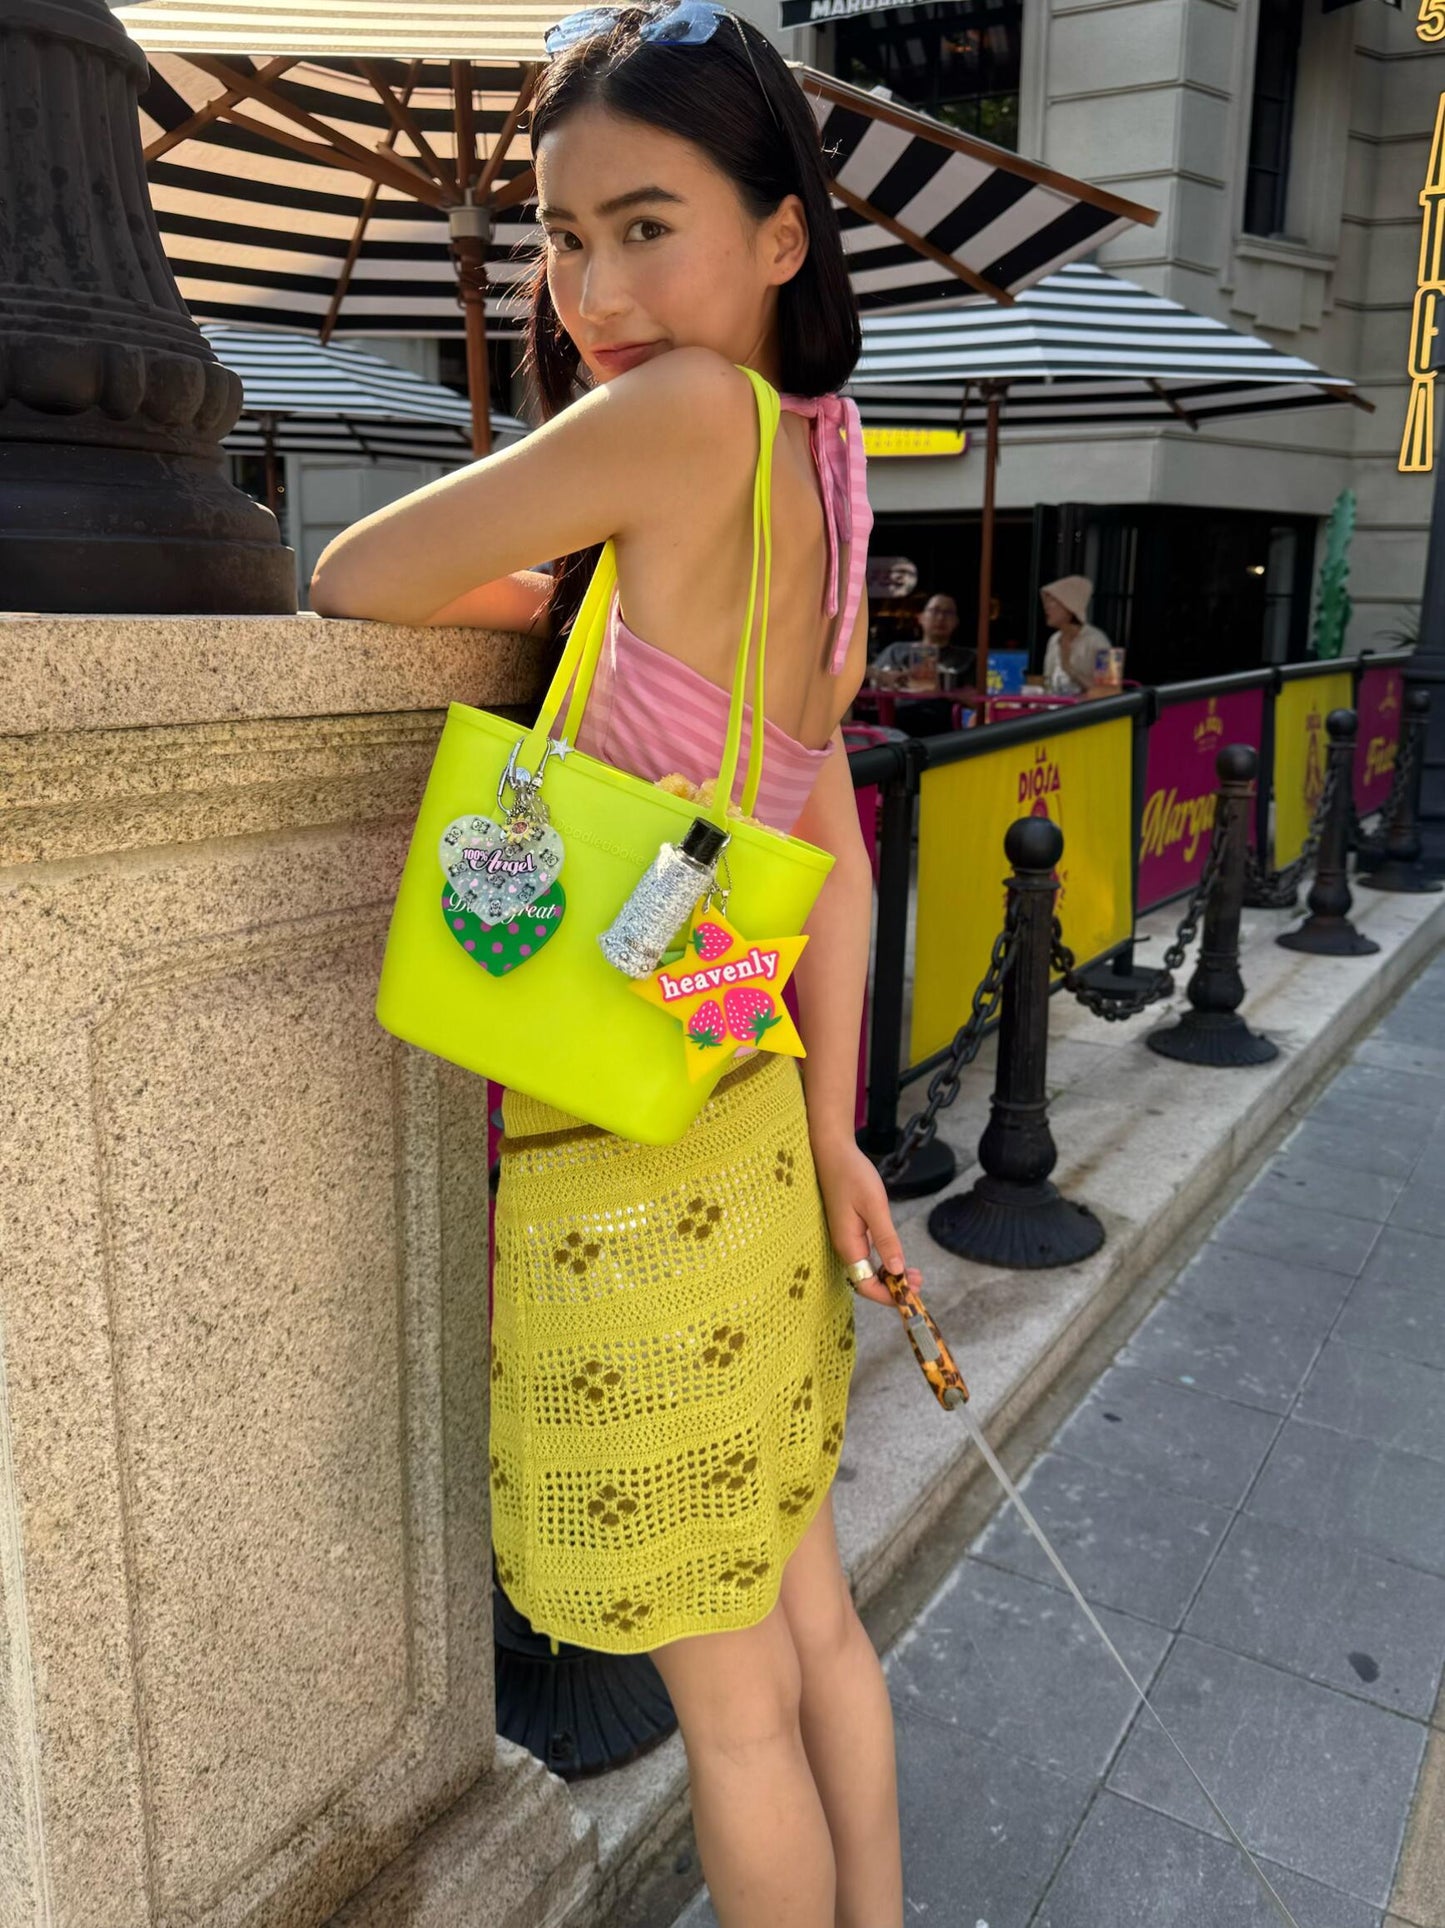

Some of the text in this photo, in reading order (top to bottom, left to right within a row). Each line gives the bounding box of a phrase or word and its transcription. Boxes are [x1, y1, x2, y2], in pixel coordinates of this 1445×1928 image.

[1034, 746, 1047, 764] LA
[1018, 762, 1061, 804] DIOSA
[1138, 786, 1218, 865] Marga
[463, 848, 538, 876] 100% Angel
[658, 948, 779, 1000] heavenly
